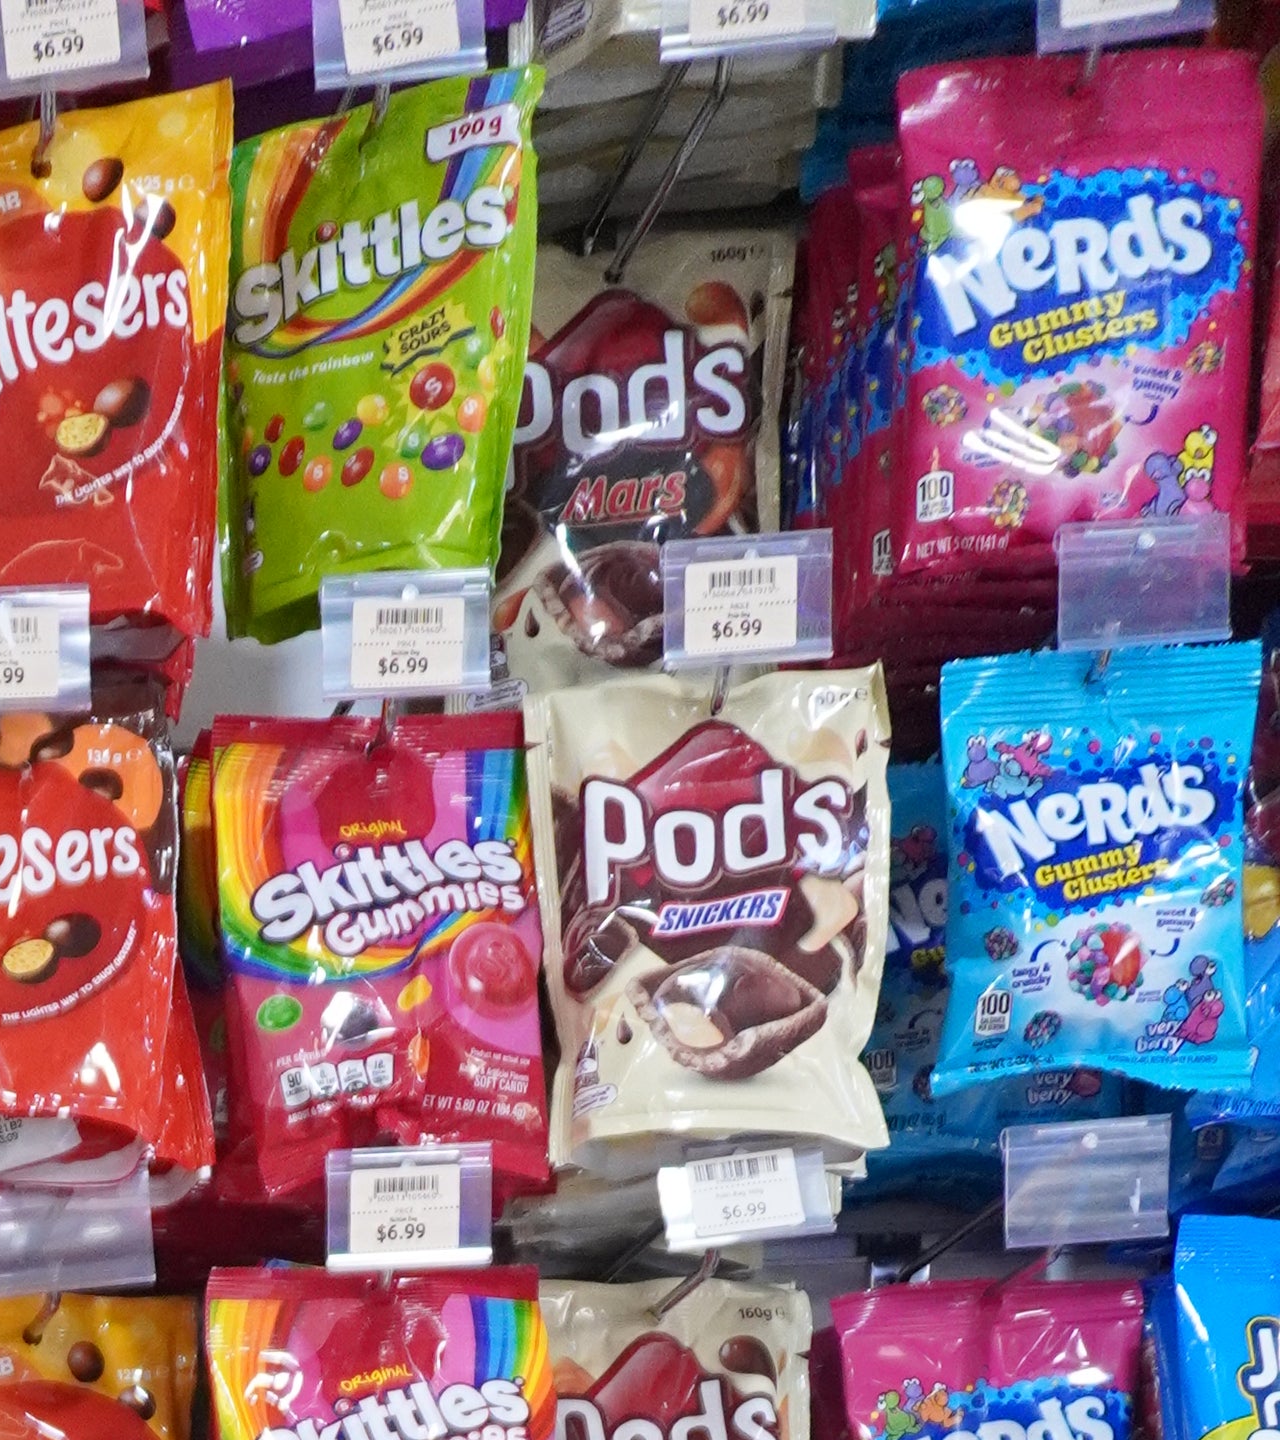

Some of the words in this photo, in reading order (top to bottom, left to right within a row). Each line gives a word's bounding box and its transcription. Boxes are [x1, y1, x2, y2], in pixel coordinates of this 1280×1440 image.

[718, 3, 769, 25] $6.99
[447, 120, 482, 143] 190
[232, 184, 515, 346] Skittles
[395, 308, 447, 346] CRAZY
[989, 292, 1127, 351] Gummy
[1020, 308, 1159, 366] Clusters
[400, 327, 452, 364] SOURS
[561, 469, 687, 526] Mars
[919, 477, 951, 499] 100
[583, 767, 850, 904] Pods
[327, 883, 525, 955] Gummies
[660, 892, 784, 933] SNICKERS
[22, 1002, 59, 1018] LIGHTER
[60, 992, 79, 1006] WAY
[80, 983, 92, 994] TO
[721, 1199, 768, 1220] $6.99
[376, 1223, 426, 1242] $6.99
